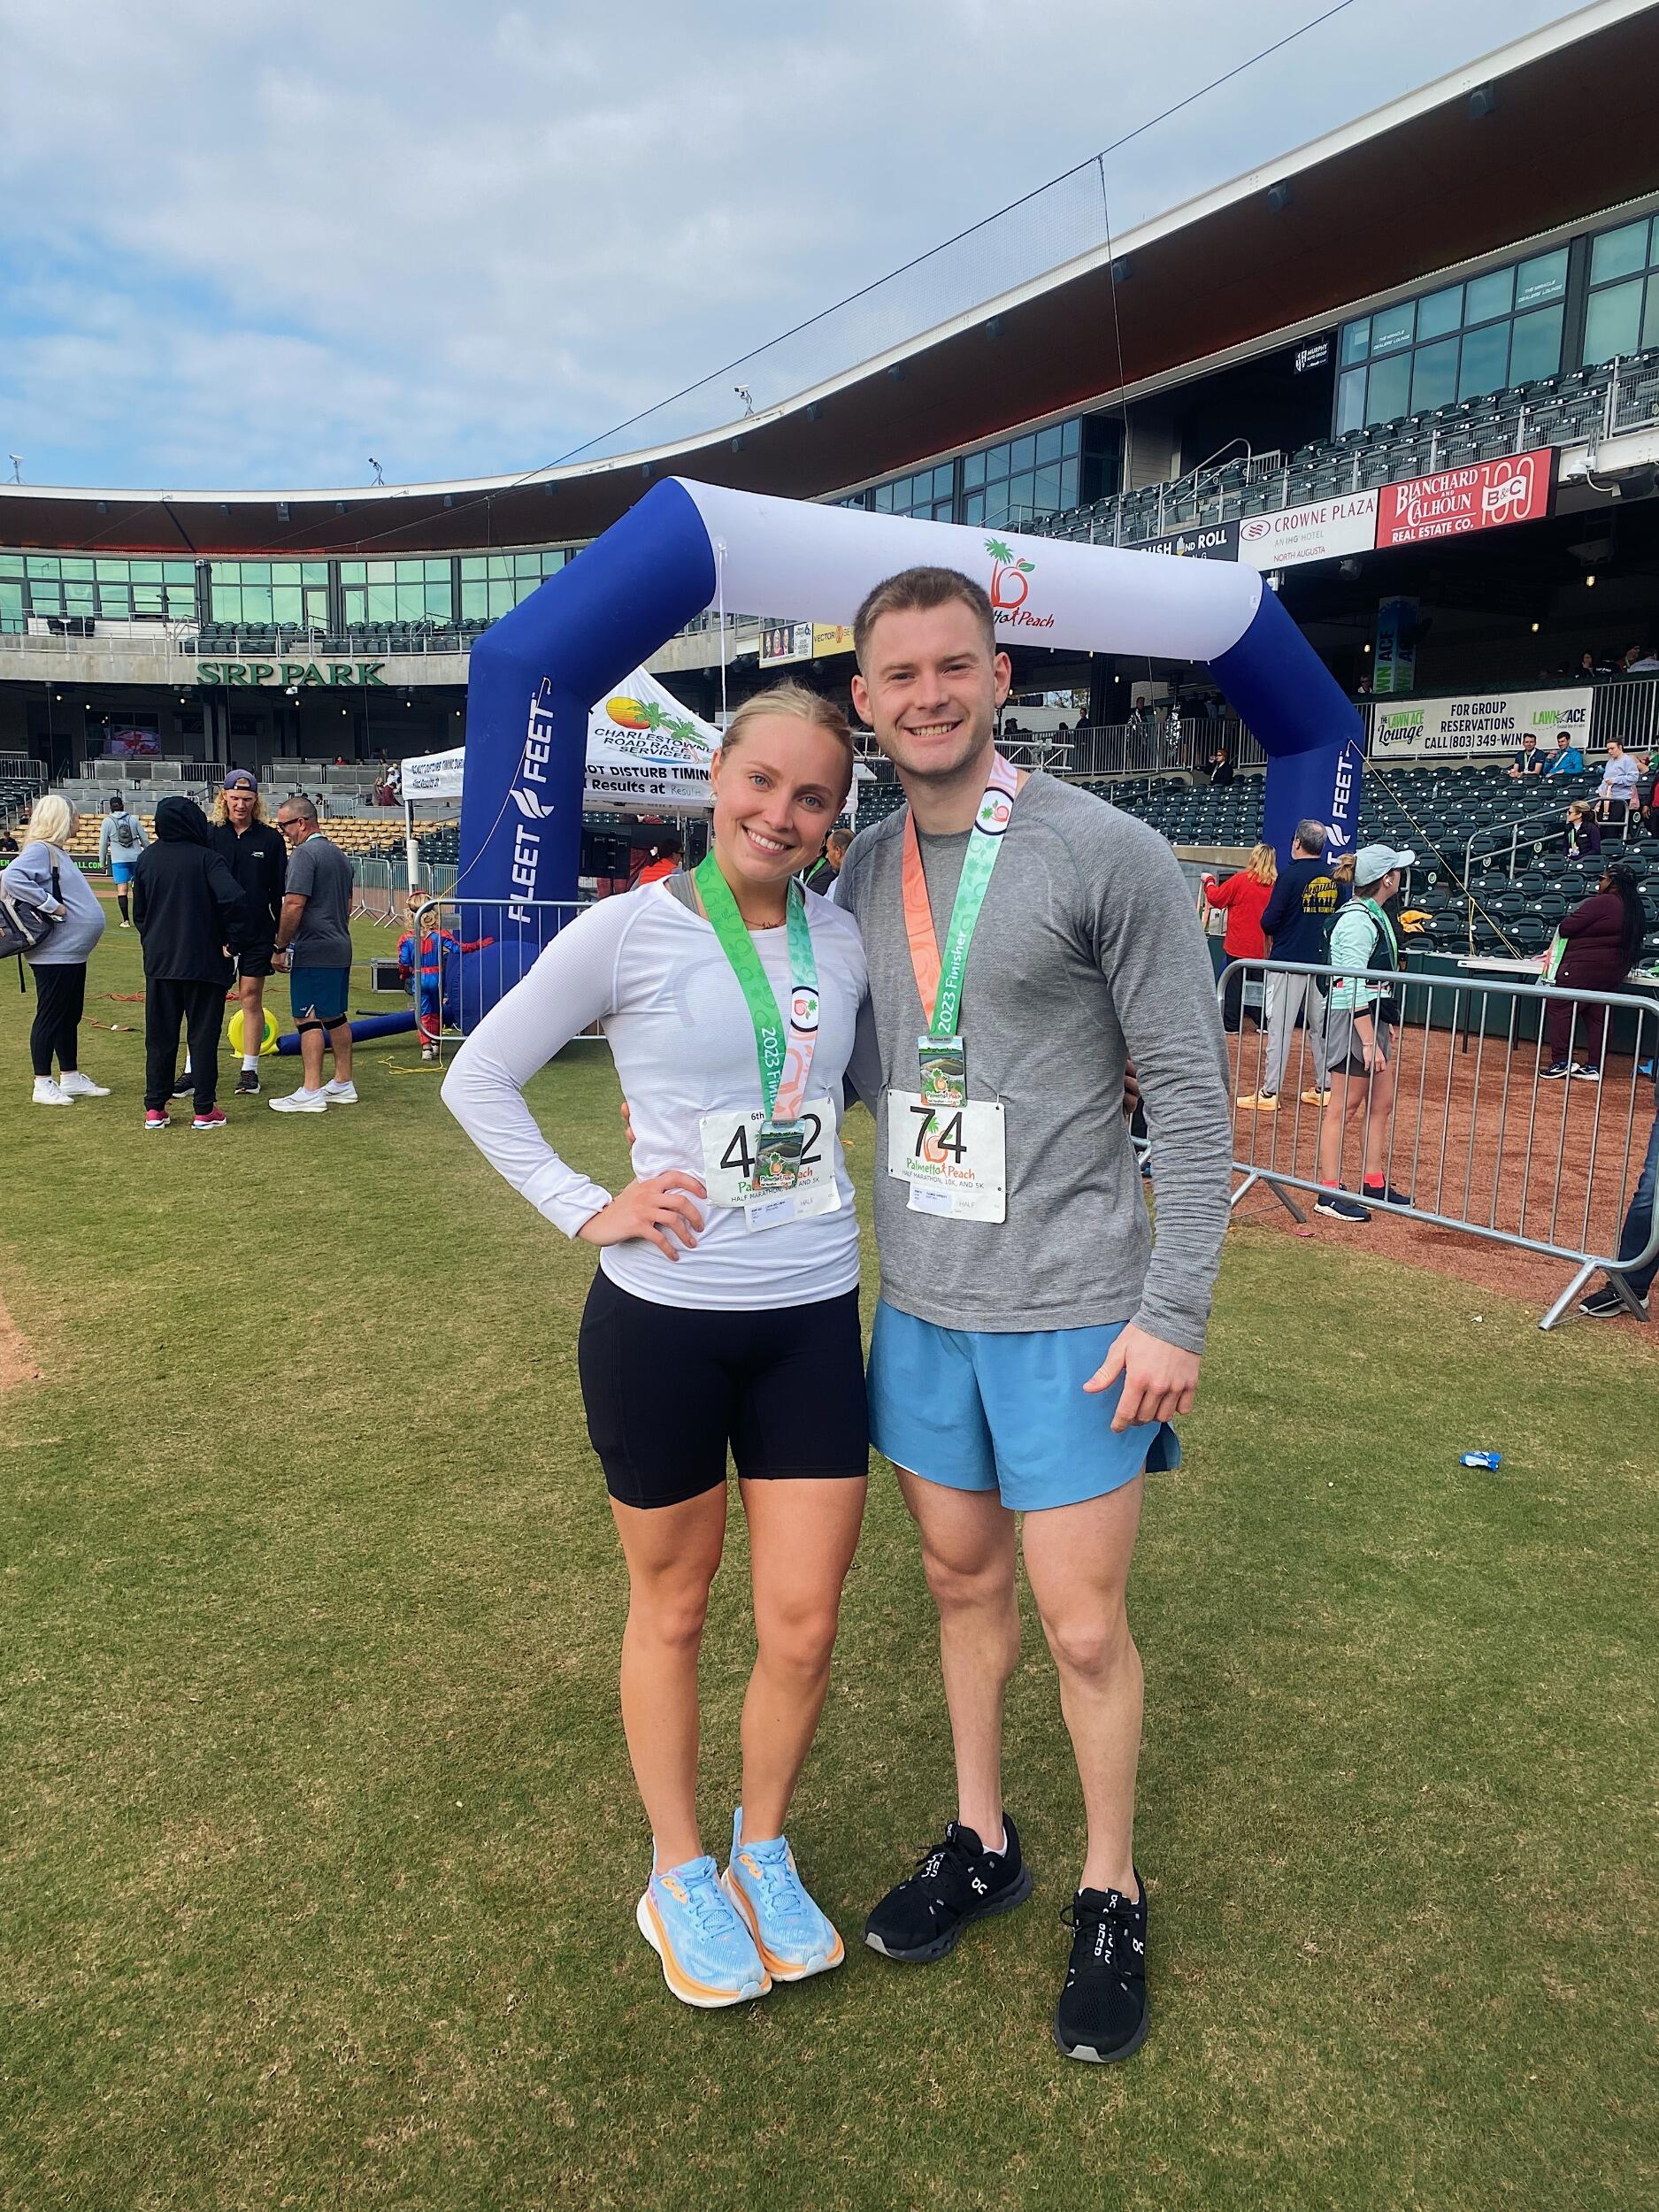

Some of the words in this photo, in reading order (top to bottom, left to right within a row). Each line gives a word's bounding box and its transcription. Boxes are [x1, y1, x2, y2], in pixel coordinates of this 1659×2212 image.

[1395, 469, 1479, 518] BLANCHARD
[1274, 508, 1327, 533] CROWNE
[1333, 497, 1374, 520] PLAZA
[1407, 492, 1472, 527] CALHOUN
[1198, 529, 1227, 549] ROLL
[1274, 538, 1285, 547] AN
[1286, 534, 1299, 544] IHG
[1301, 530, 1325, 541] HOTEL
[1392, 527, 1416, 543] REAL
[1418, 522, 1452, 539] ESTATE
[1455, 518, 1474, 531] CO.
[1274, 553, 1296, 562] NORTH
[1296, 546, 1325, 558] AUGUSTA
[1018, 611, 1055, 628] Peach
[813, 631, 835, 642] VECTOR
[196, 662, 273, 686] SRP
[279, 663, 388, 686] PARK
[1451, 703, 1471, 717] FOR
[1471, 701, 1507, 715] GROUP
[1532, 710, 1560, 726] LAWN
[1567, 708, 1586, 723] ACE
[1388, 713, 1409, 728] LAWN
[1410, 711, 1425, 726] ACE
[1440, 717, 1515, 733] RESERVATIONS
[523, 699, 554, 783] FEET
[595, 728, 715, 754] CHARLESTOWNE
[603, 737, 646, 748] ROAD
[650, 742, 689, 754] RACE
[1378, 725, 1424, 746] Lounge
[1425, 736, 1448, 749] CALL
[1450, 734, 1475, 749] (803)
[619, 746, 691, 760] SERVICES
[610, 766, 667, 778] DISTURB
[672, 767, 711, 780] TIMIN
[592, 780, 645, 794] Results
[650, 783, 665, 795] at
[1333, 756, 1353, 818] FEET
[508, 824, 541, 924] FLEET
[946, 930, 967, 988] Finisher
[938, 991, 956, 1033] 2023
[762, 1027, 780, 1068] 2023
[910, 1105, 967, 1164] 74
[906, 1157, 941, 1175] Palmetto
[948, 1165, 975, 1180] Peach
[913, 1171, 943, 1185] MARATHON,
[945, 1177, 957, 1187] 10K,
